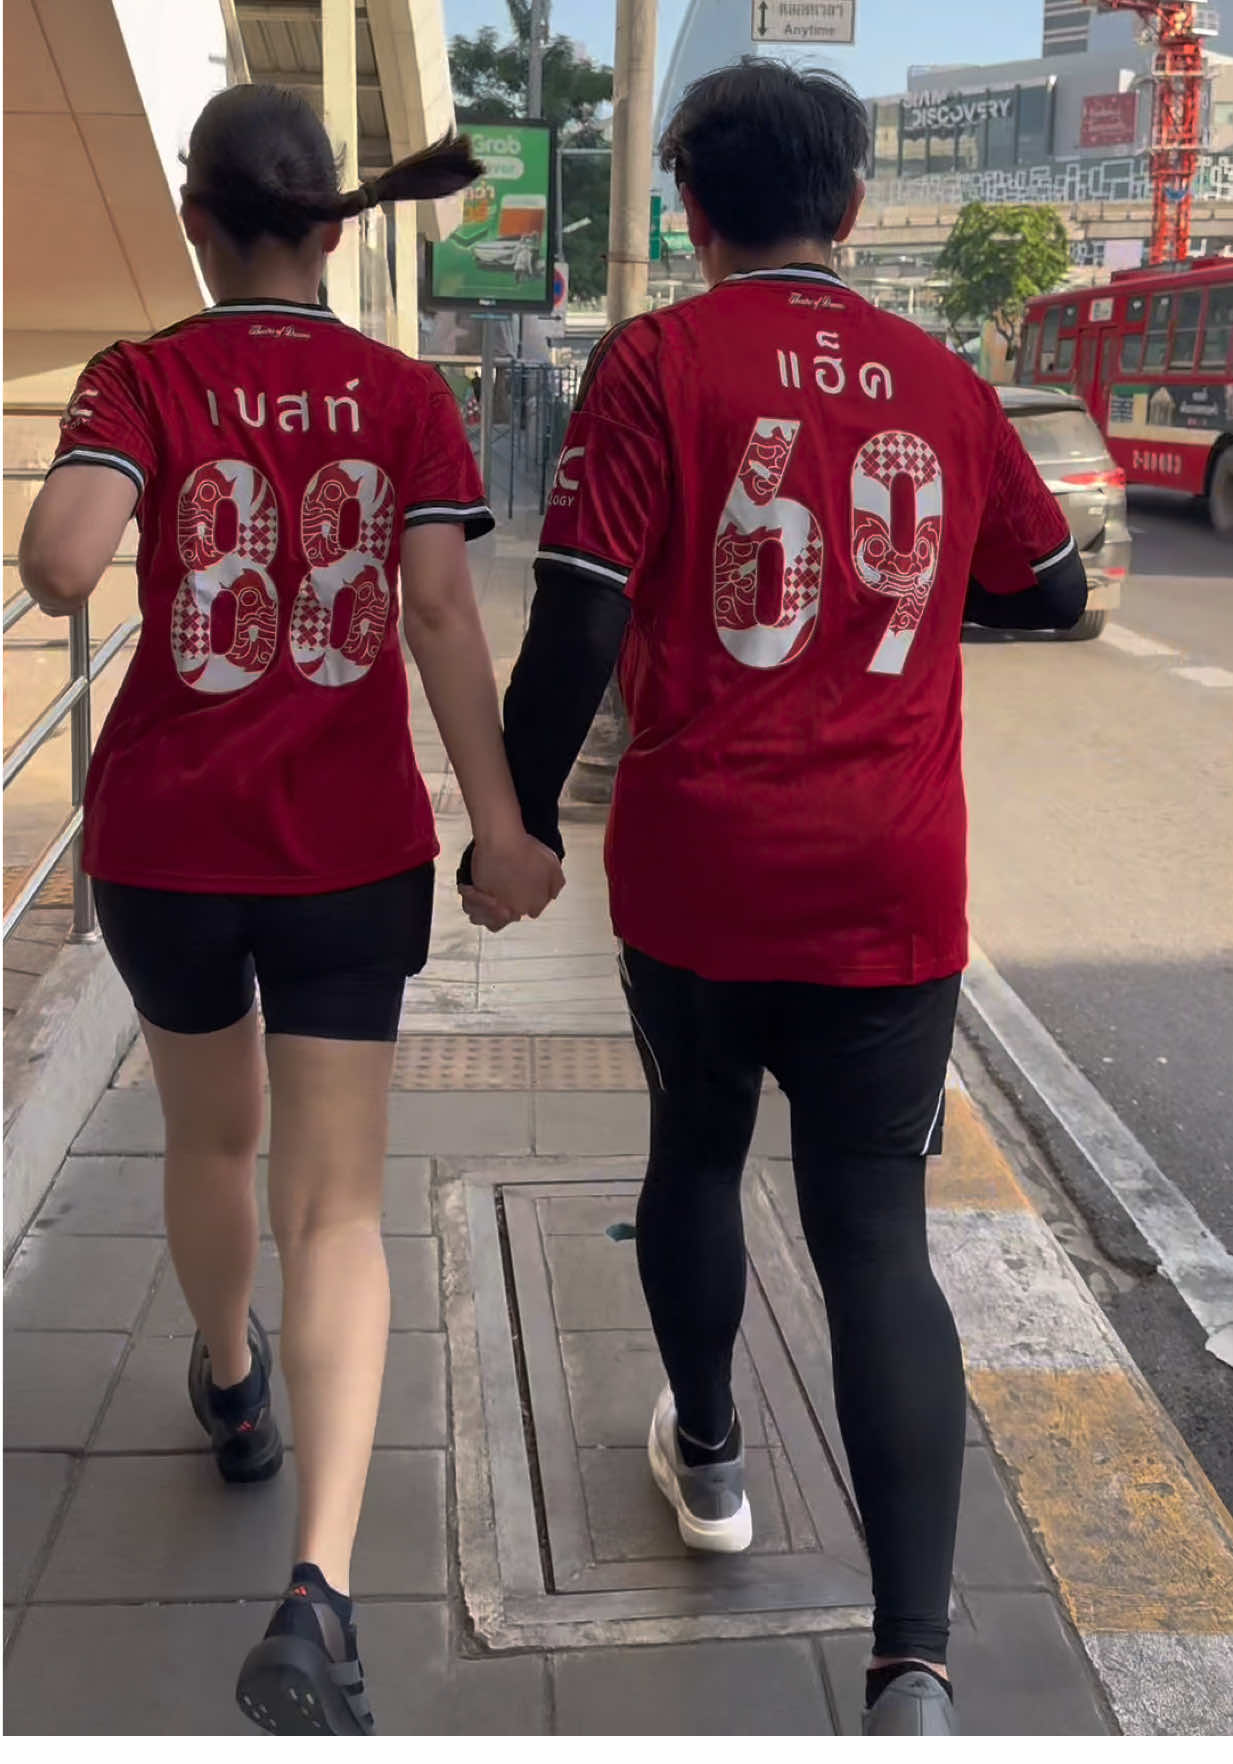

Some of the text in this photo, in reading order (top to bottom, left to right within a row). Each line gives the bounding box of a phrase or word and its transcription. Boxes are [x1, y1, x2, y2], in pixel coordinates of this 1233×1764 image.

[784, 24, 836, 38] Anytime
[911, 98, 1010, 128] DISCOVERY
[472, 134, 521, 154] Grab
[207, 378, 360, 432] เบสท์
[713, 417, 943, 675] 69
[171, 459, 396, 695] 88
